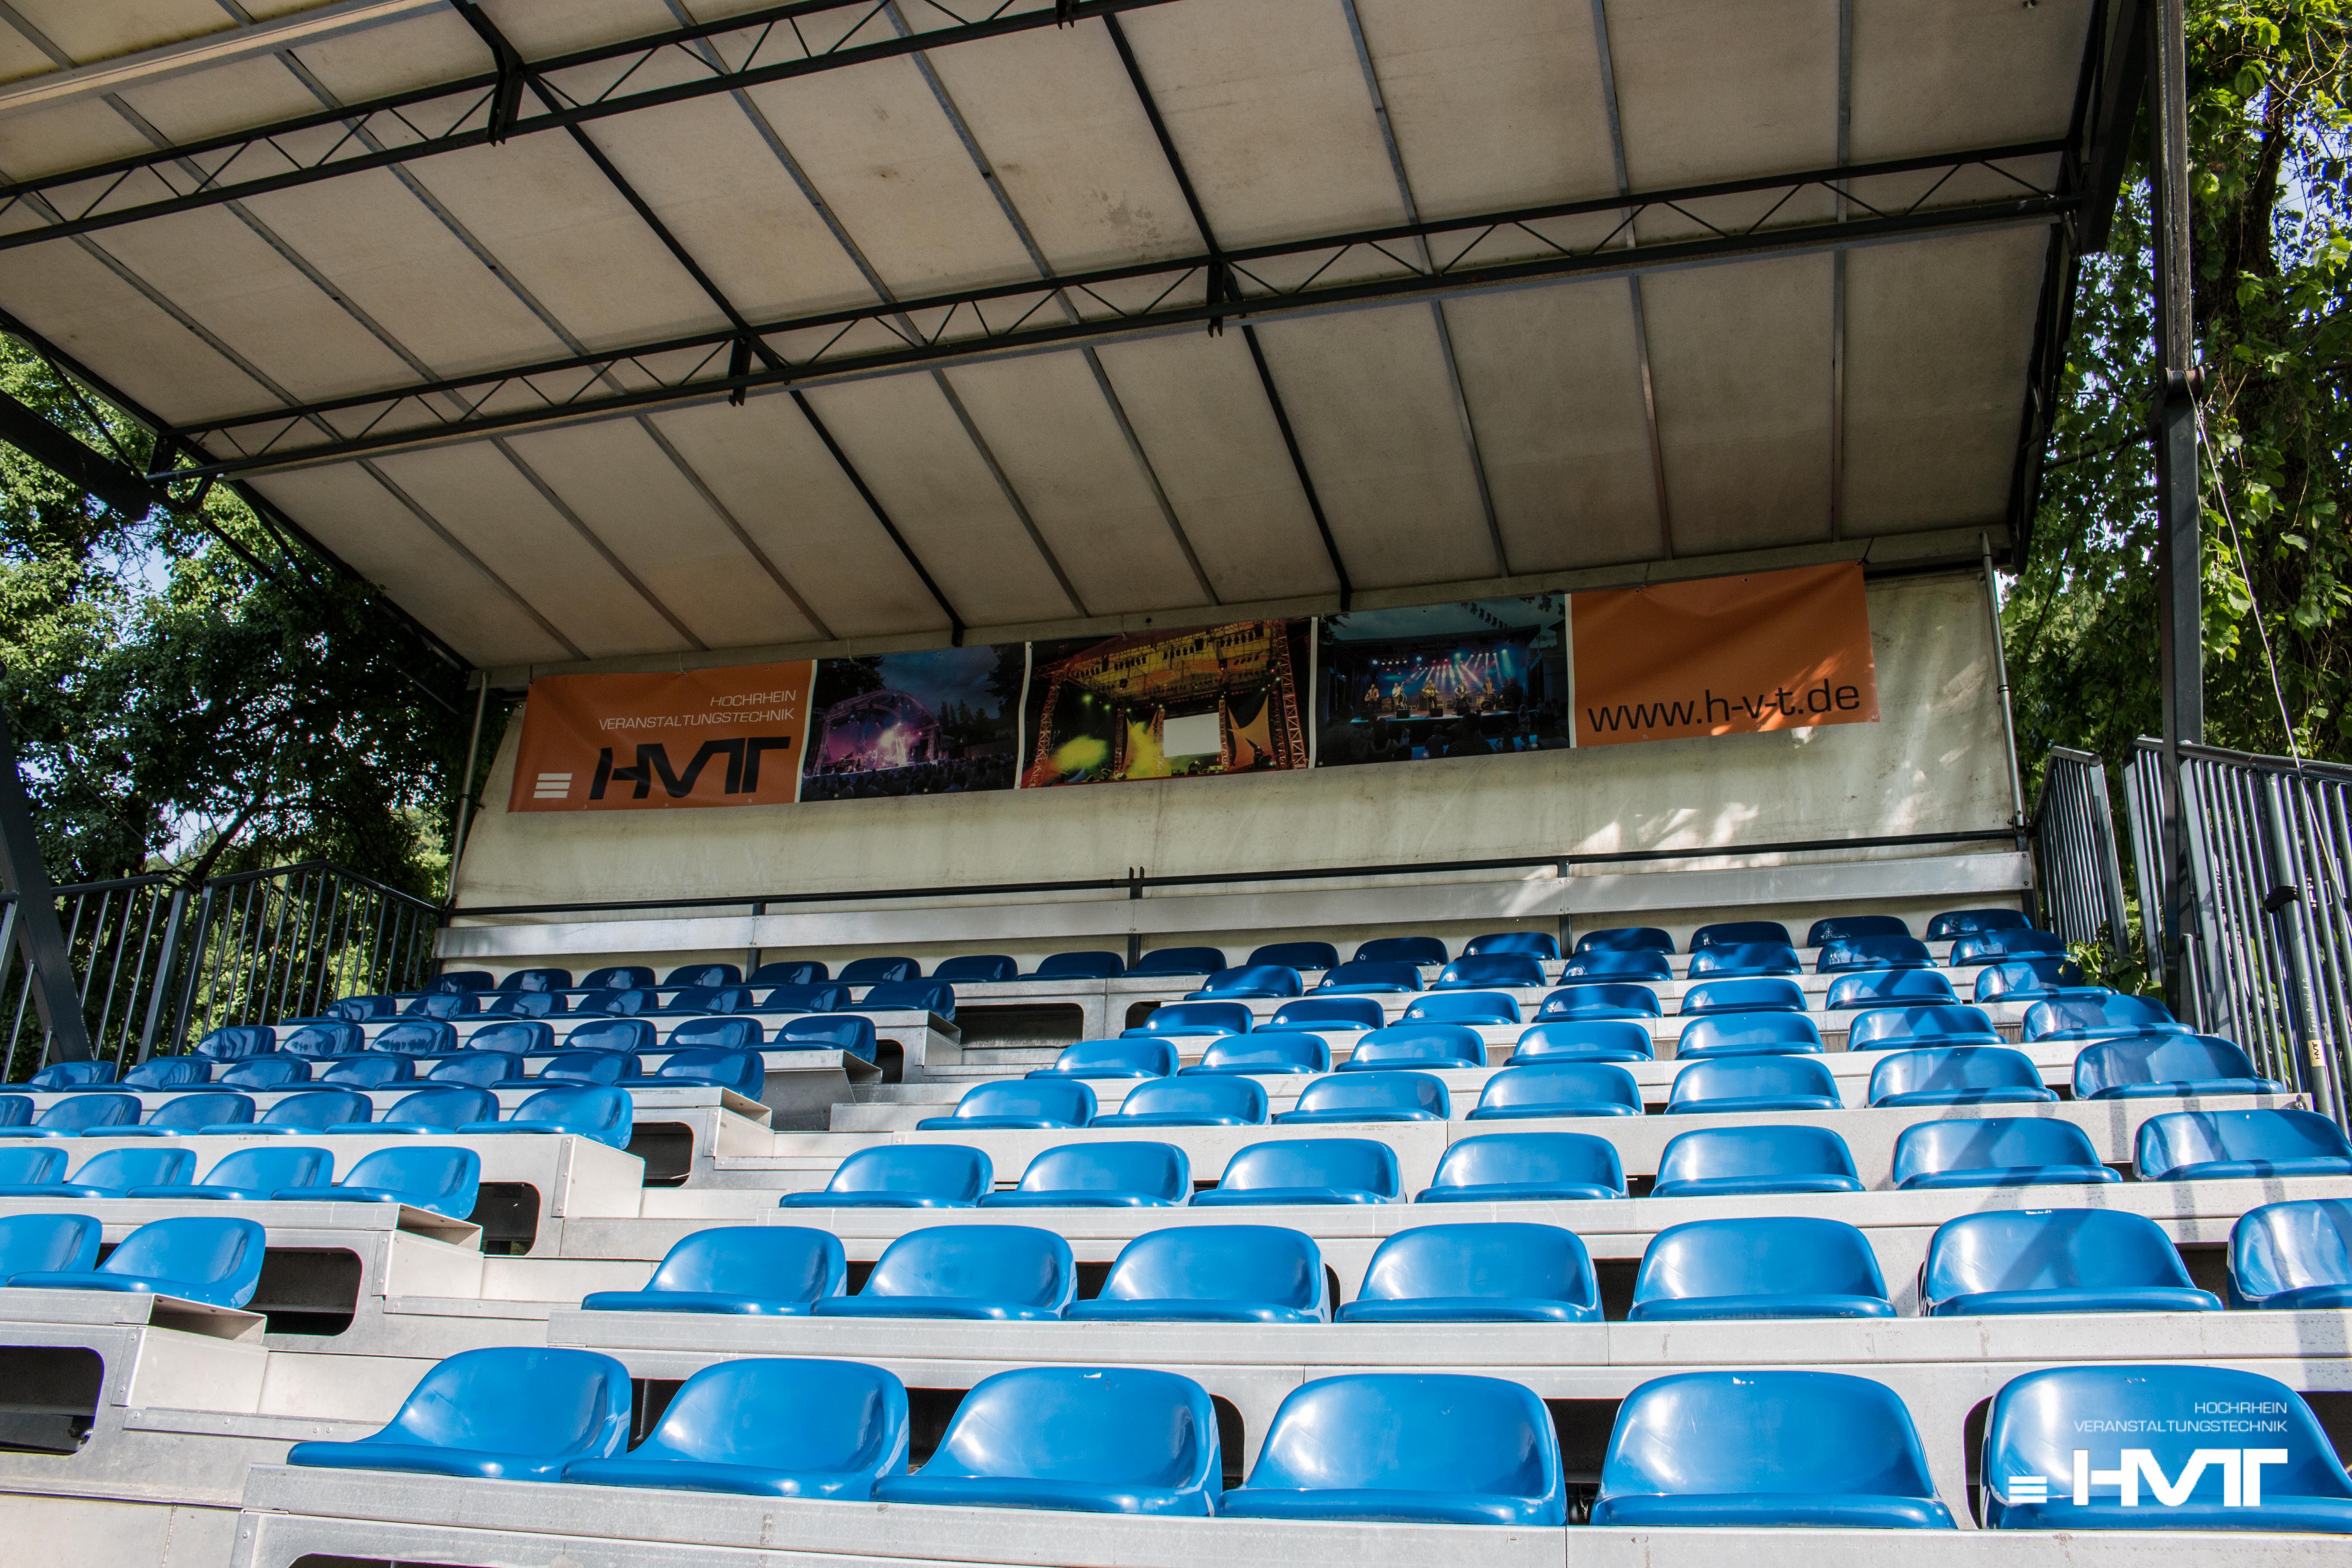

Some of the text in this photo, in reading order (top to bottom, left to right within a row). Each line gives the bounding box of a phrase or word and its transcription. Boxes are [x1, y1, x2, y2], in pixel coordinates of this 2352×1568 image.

[710, 690, 796, 707] HOCHRHEIN
[1587, 679, 1860, 732] www.h-v-t.de
[599, 708, 794, 730] VERANSTALTUNGSTECHNIK
[589, 737, 791, 800] HVT
[2312, 1041, 2320, 1060] HVT
